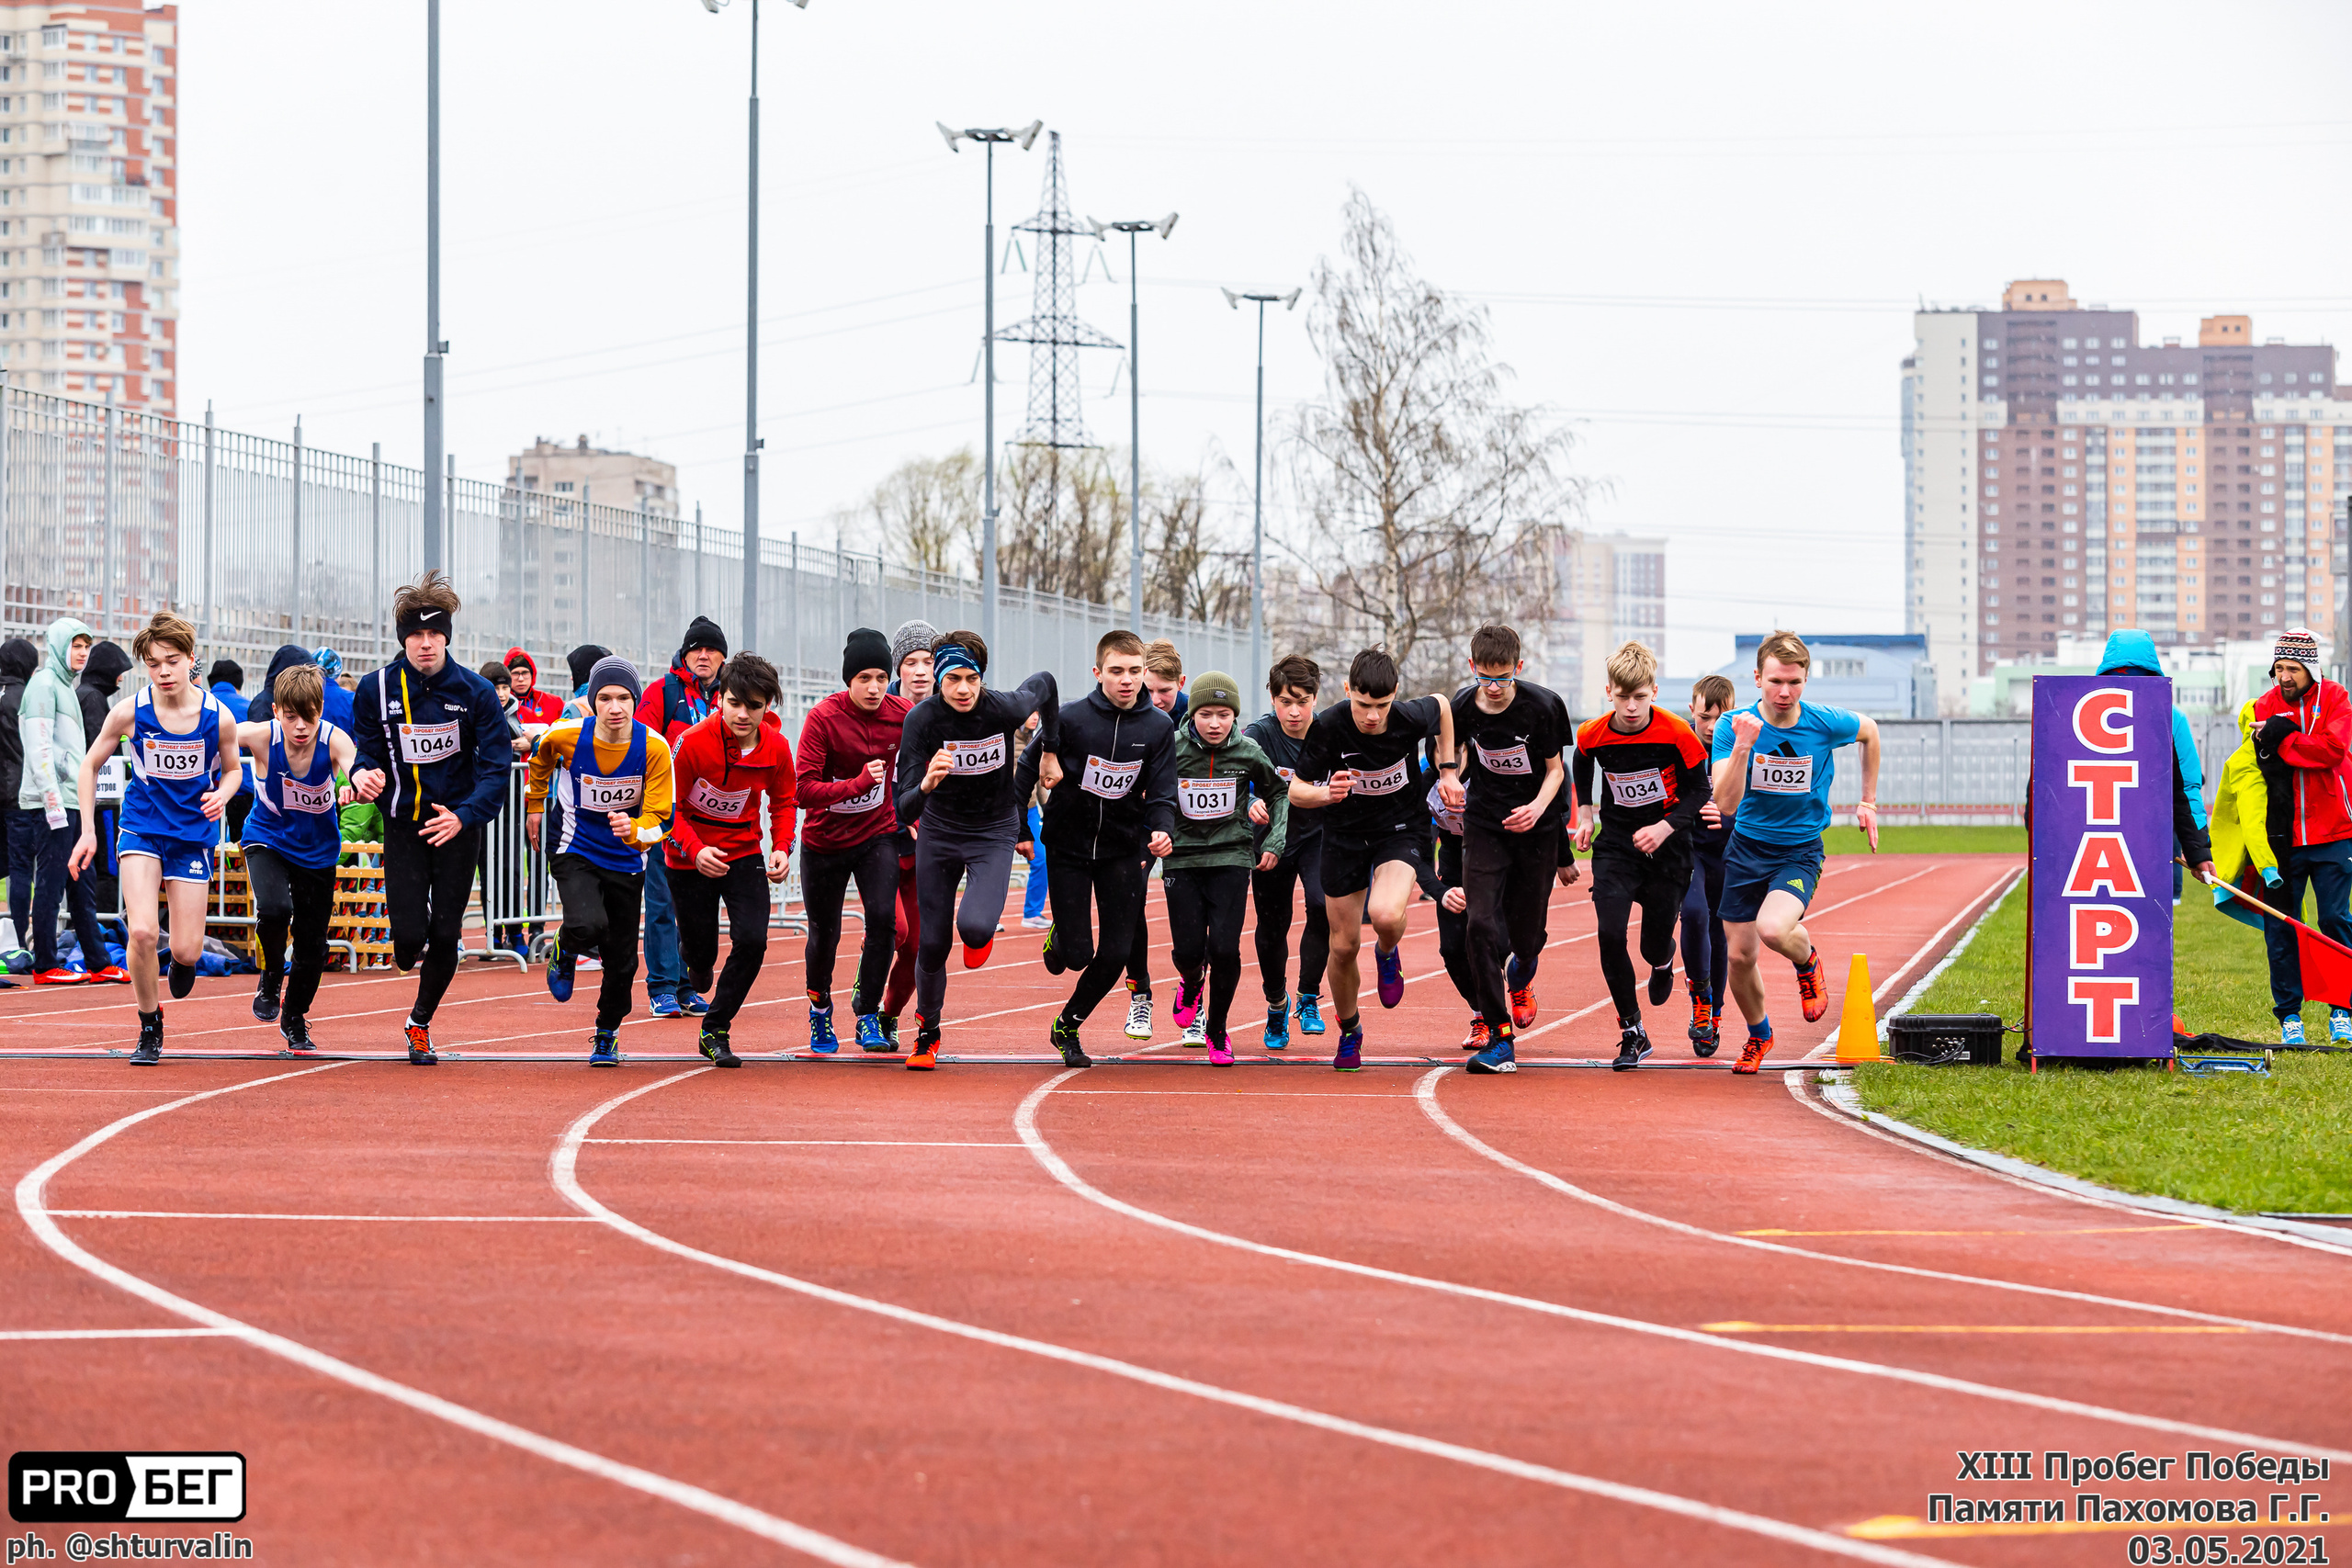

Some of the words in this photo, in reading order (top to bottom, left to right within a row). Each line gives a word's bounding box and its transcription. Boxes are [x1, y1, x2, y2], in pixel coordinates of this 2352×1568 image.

[435, 724, 458, 732] ПОБЕДЫ
[411, 736, 453, 753] 1046
[981, 737, 1003, 747] ПОБЕДЫ
[154, 753, 198, 770] 1039
[956, 749, 1000, 767] 1044
[1482, 755, 1523, 768] 1043
[99, 765, 111, 775] 000
[1762, 769, 1805, 784] 1032
[96, 783, 117, 792] етров
[1094, 772, 1133, 789] 1049
[1360, 773, 1402, 789] 1048
[591, 788, 635, 803] 1042
[1617, 781, 1658, 798] 1034
[292, 791, 331, 806] 1040
[699, 792, 741, 812] 1035
[1187, 793, 1227, 808] 1031
[2063, 687, 2145, 1043] СТАРТ
